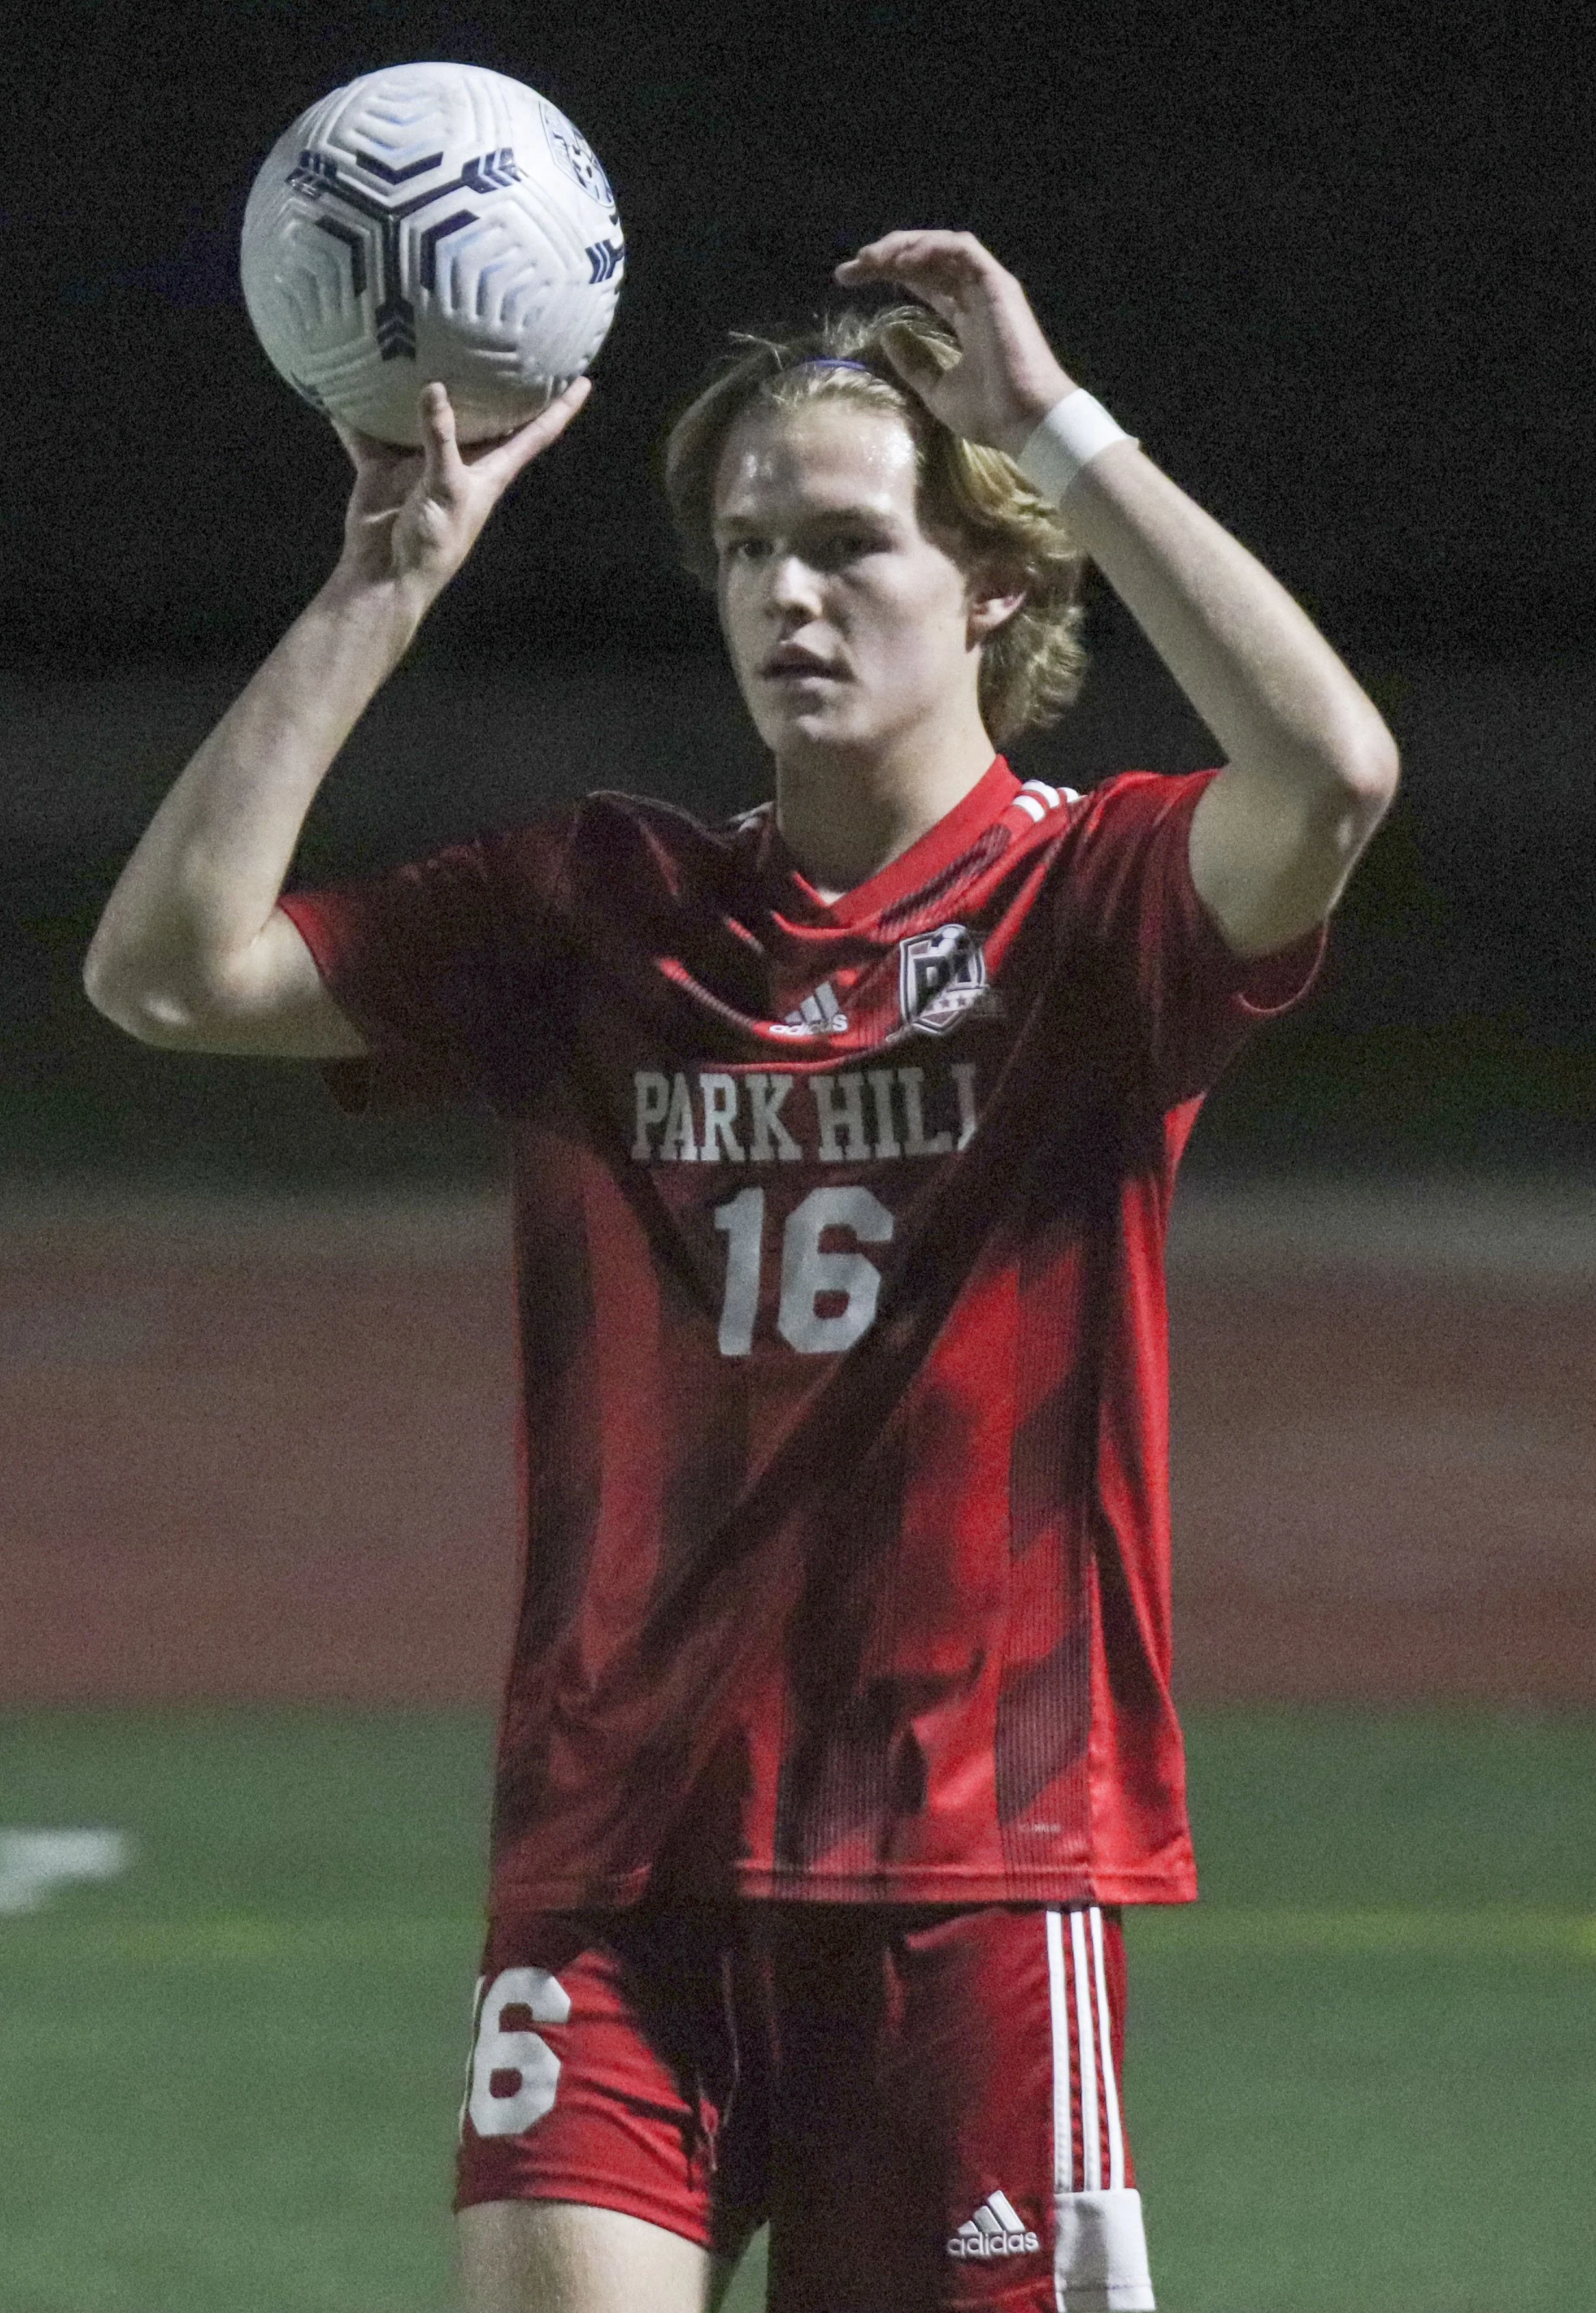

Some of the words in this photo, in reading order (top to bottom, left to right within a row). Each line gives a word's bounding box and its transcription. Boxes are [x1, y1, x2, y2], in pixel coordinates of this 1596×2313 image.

[631, 1071, 803, 1161] PARK
[715, 1186, 893, 1356] 16
[459, 1967, 572, 2143] 6
[947, 2230, 1039, 2258] adidas
